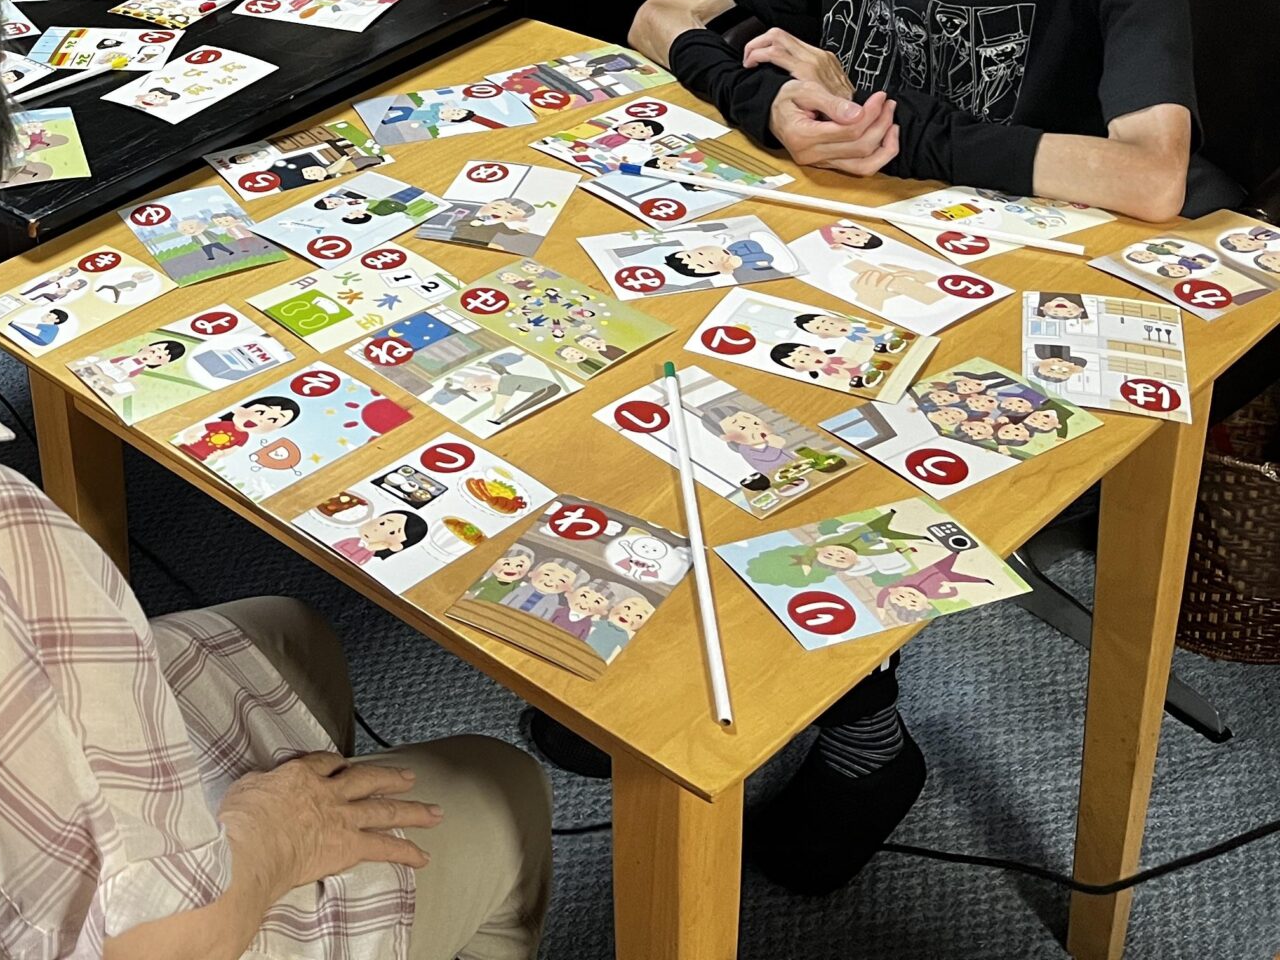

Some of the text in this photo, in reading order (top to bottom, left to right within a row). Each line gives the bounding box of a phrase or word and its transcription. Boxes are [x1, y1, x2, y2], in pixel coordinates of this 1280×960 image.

[470, 87, 498, 96] の
[134, 207, 166, 223] ゆ
[313, 239, 347, 257] ひ
[84, 254, 116, 270] き
[364, 252, 401, 268] ま
[332, 271, 362, 286] 火
[393, 273, 413, 284] 1
[421, 280, 440, 293] 2
[620, 269, 661, 289] お
[943, 279, 986, 294] ち
[337, 289, 364, 306] 水
[373, 293, 402, 310] 木
[466, 291, 507, 311] せ
[1182, 284, 1227, 305] か
[194, 317, 232, 333] よ
[355, 313, 384, 331] 金
[710, 329, 751, 348] て
[244, 342, 272, 364] ATM
[367, 340, 412, 364] ね
[1127, 382, 1171, 408] は
[620, 411, 662, 428] し
[915, 456, 956, 477] う
[554, 508, 601, 535] わ
[795, 602, 846, 625] り
